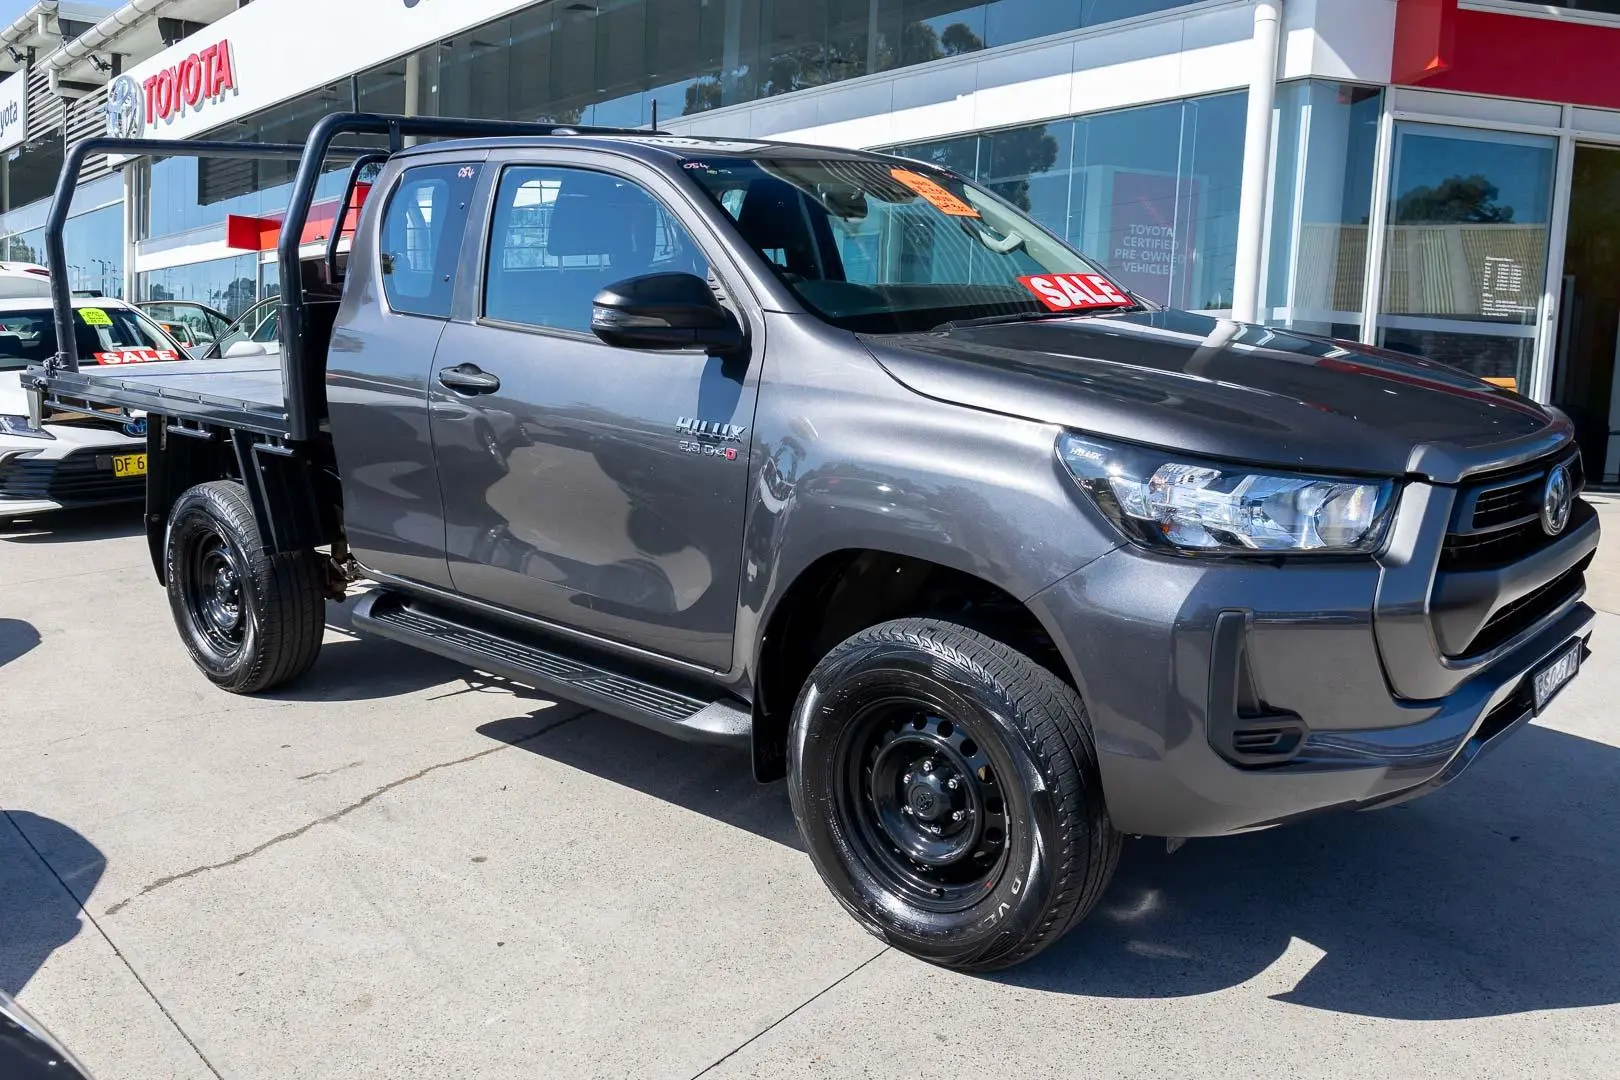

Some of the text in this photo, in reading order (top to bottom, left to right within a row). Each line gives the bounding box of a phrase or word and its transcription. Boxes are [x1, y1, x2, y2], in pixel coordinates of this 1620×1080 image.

[143, 38, 233, 124] TOYOTA
[1128, 224, 1176, 237] TOYOTA
[1123, 236, 1180, 250] CERTIFIED
[1123, 262, 1176, 275] VEHICLES
[1030, 275, 1127, 308] SALE
[101, 350, 176, 365] SALE
[675, 416, 747, 442] HILUX
